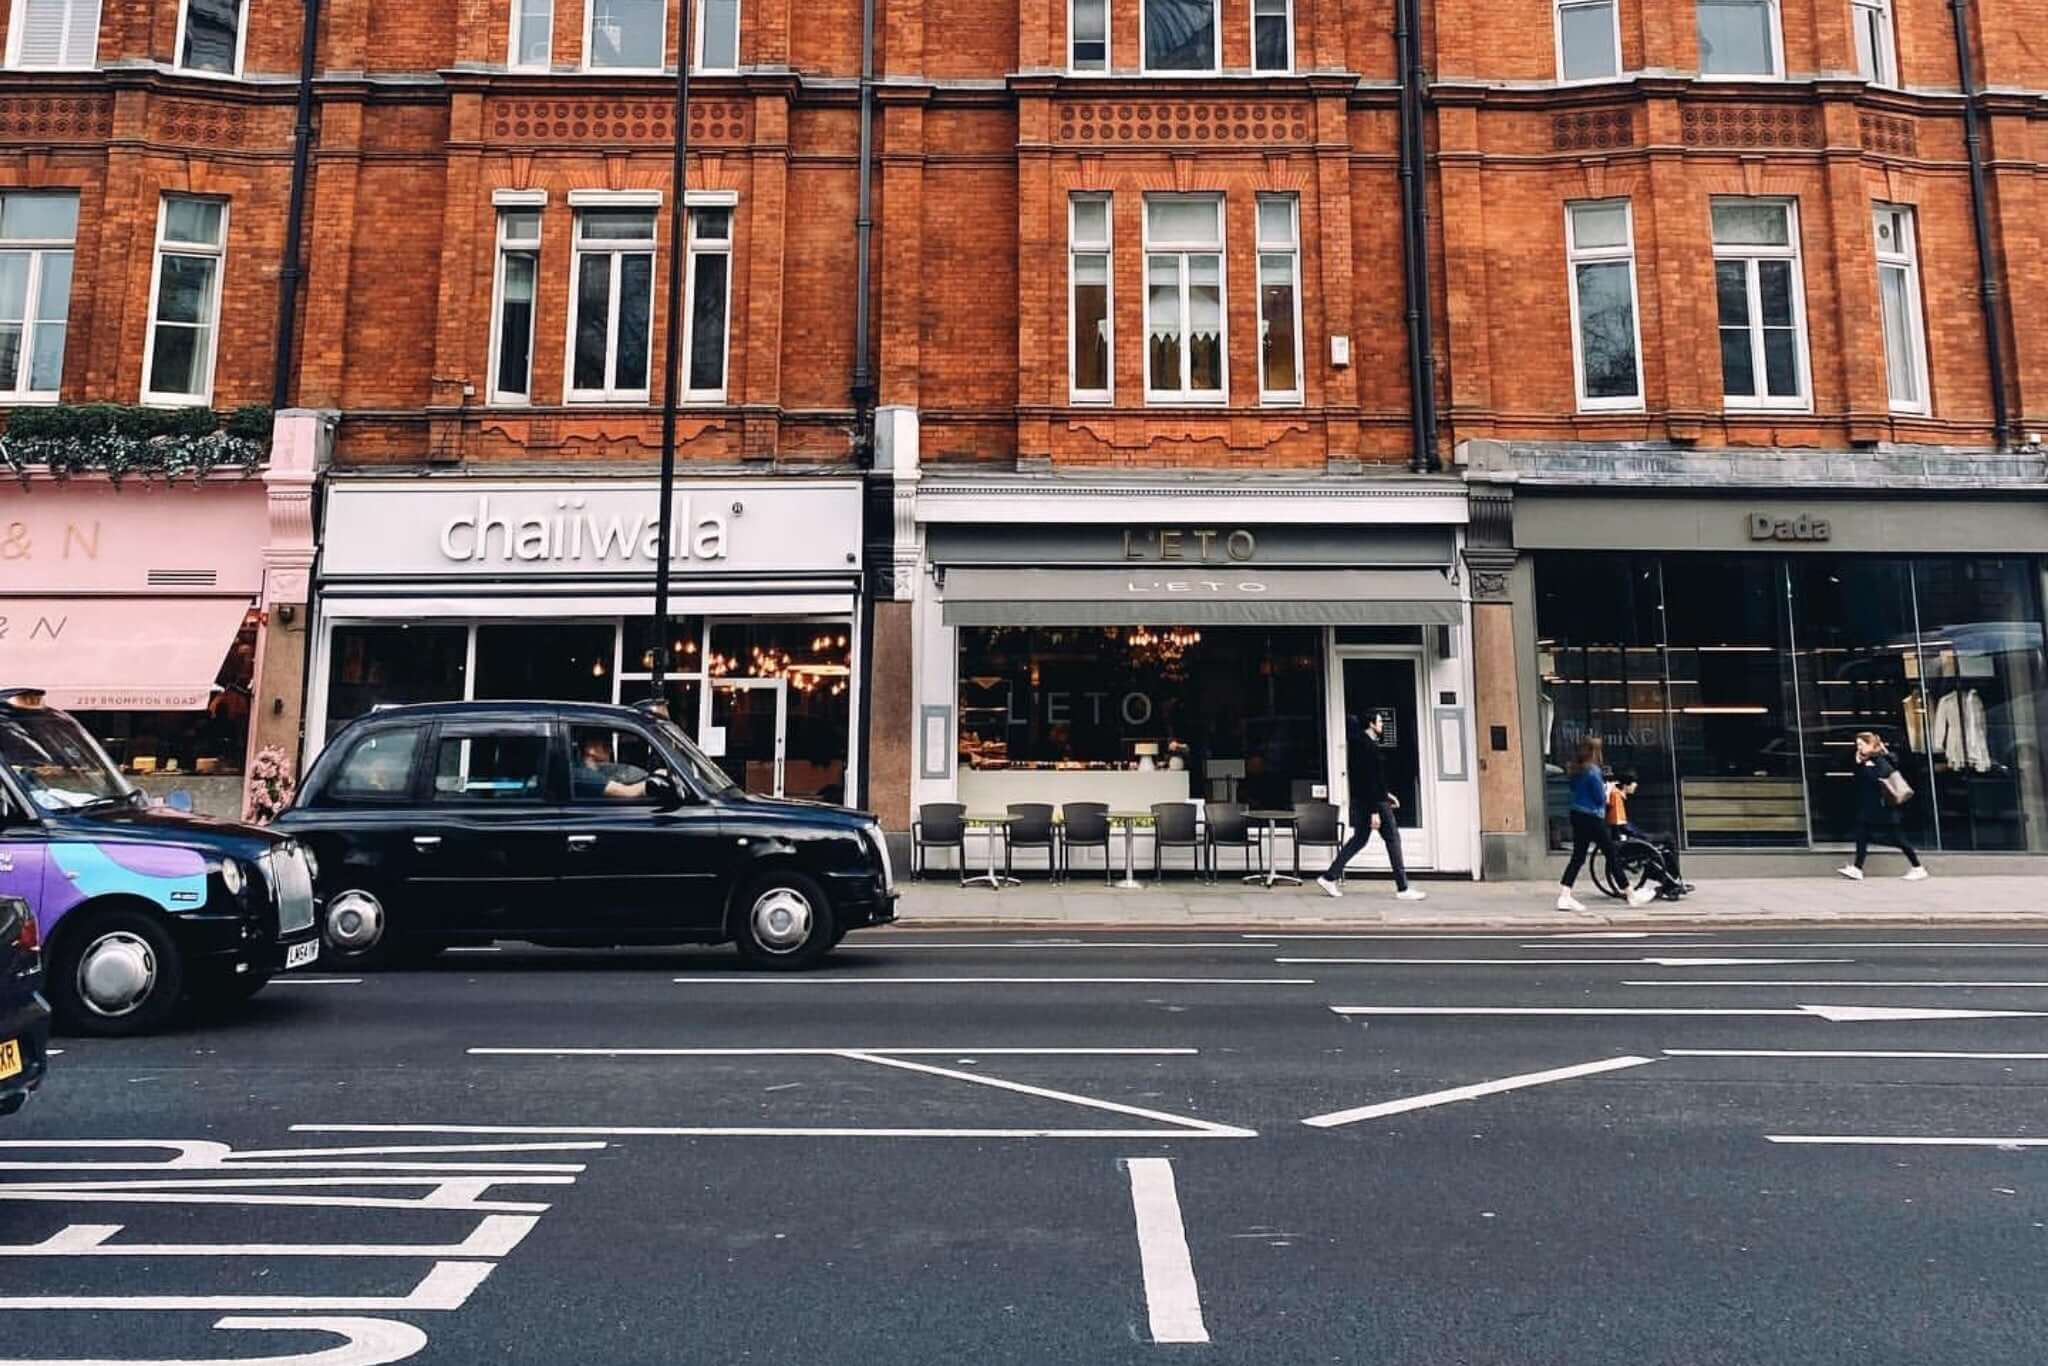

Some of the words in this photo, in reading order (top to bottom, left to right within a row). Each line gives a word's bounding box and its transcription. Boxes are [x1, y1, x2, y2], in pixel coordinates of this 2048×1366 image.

[1, 521, 32, 560] &
[62, 520, 102, 560] N
[1744, 511, 1832, 542] Dada
[1123, 529, 1256, 561] L'ETO
[1128, 580, 1267, 592] L'ETO
[29, 615, 68, 640] N
[165, 695, 197, 705] ROAD
[1007, 692, 1152, 725] L'ETO
